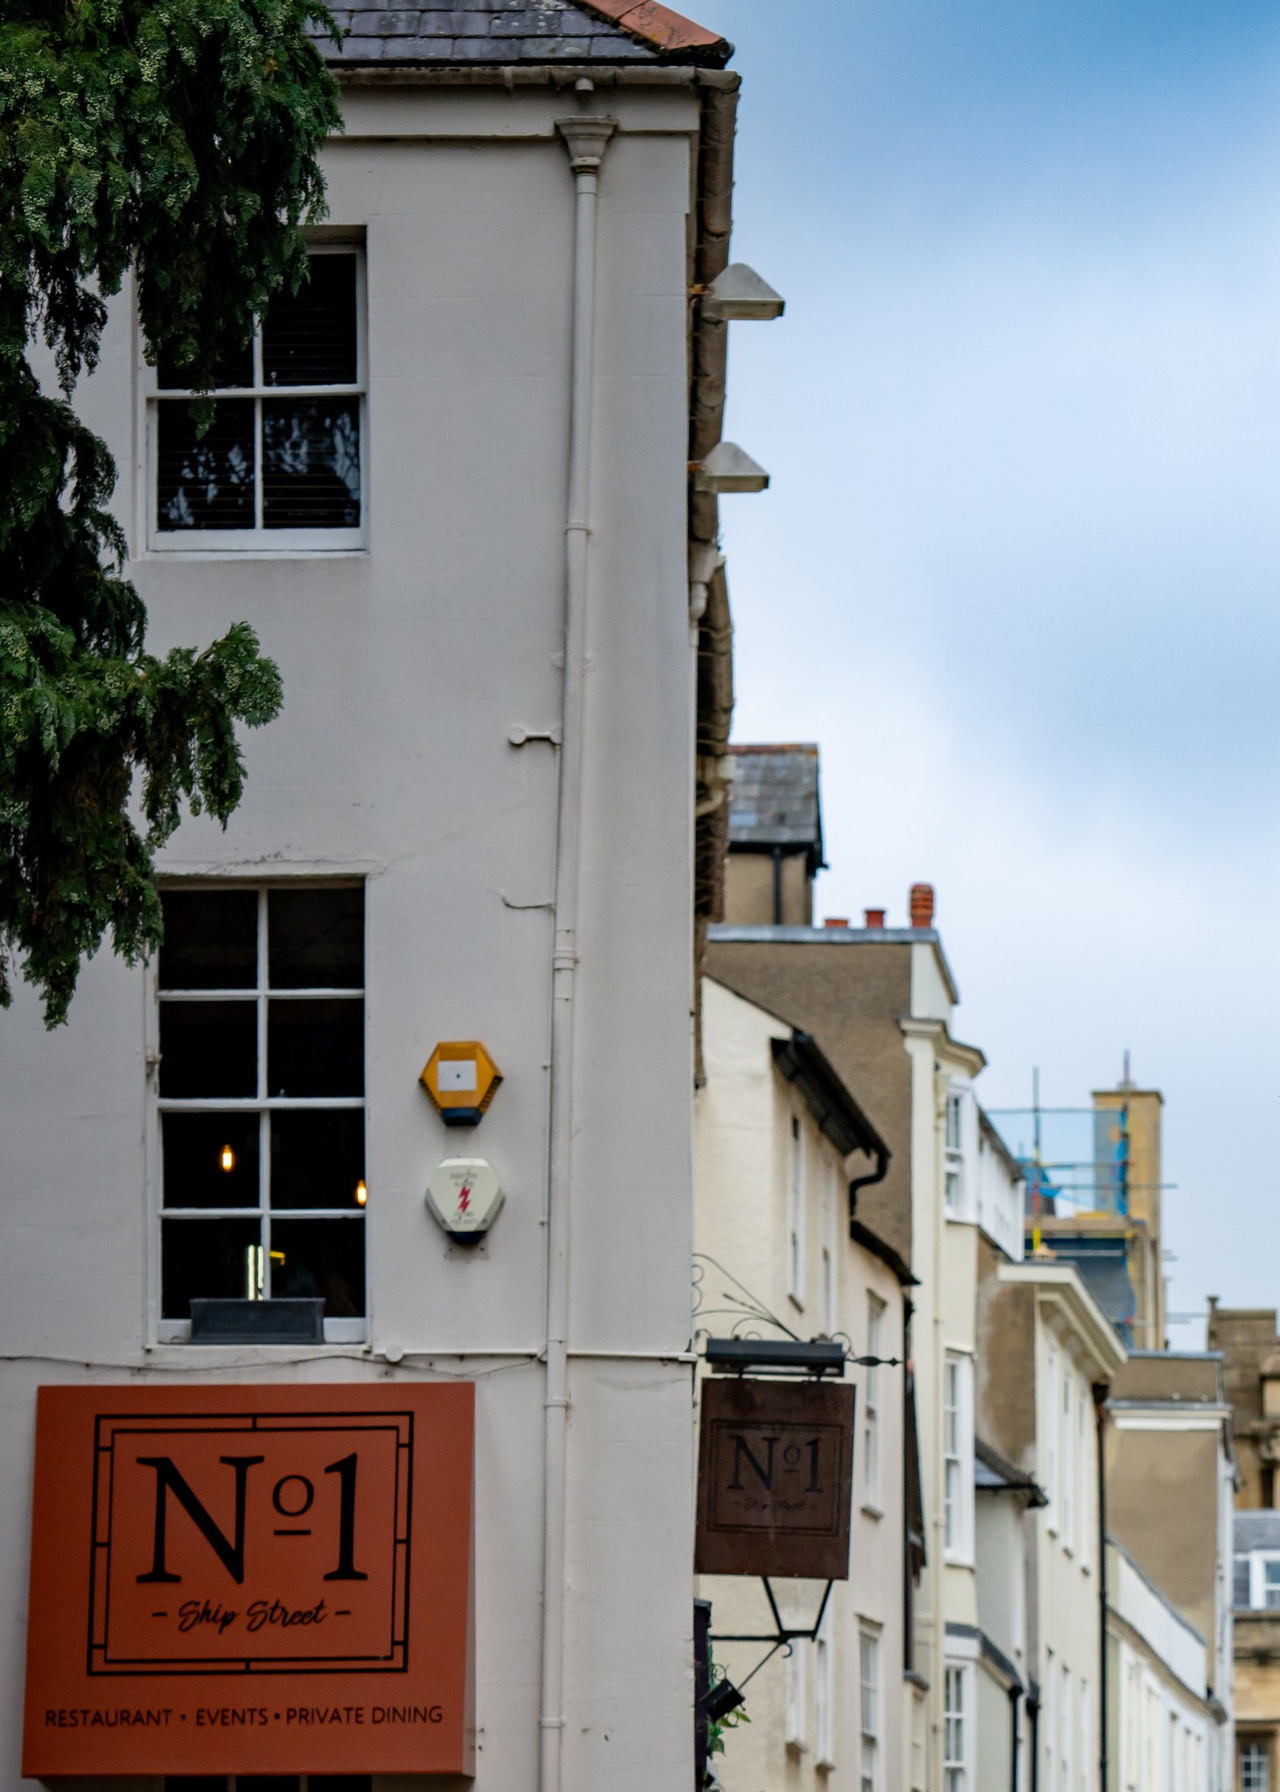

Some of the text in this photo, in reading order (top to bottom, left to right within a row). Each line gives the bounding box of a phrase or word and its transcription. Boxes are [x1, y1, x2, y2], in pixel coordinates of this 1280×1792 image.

[178, 1599, 327, 1634] Ship Street
[45, 1706, 443, 1727] RESTAURANT EVENTS PRIVATE DINING
